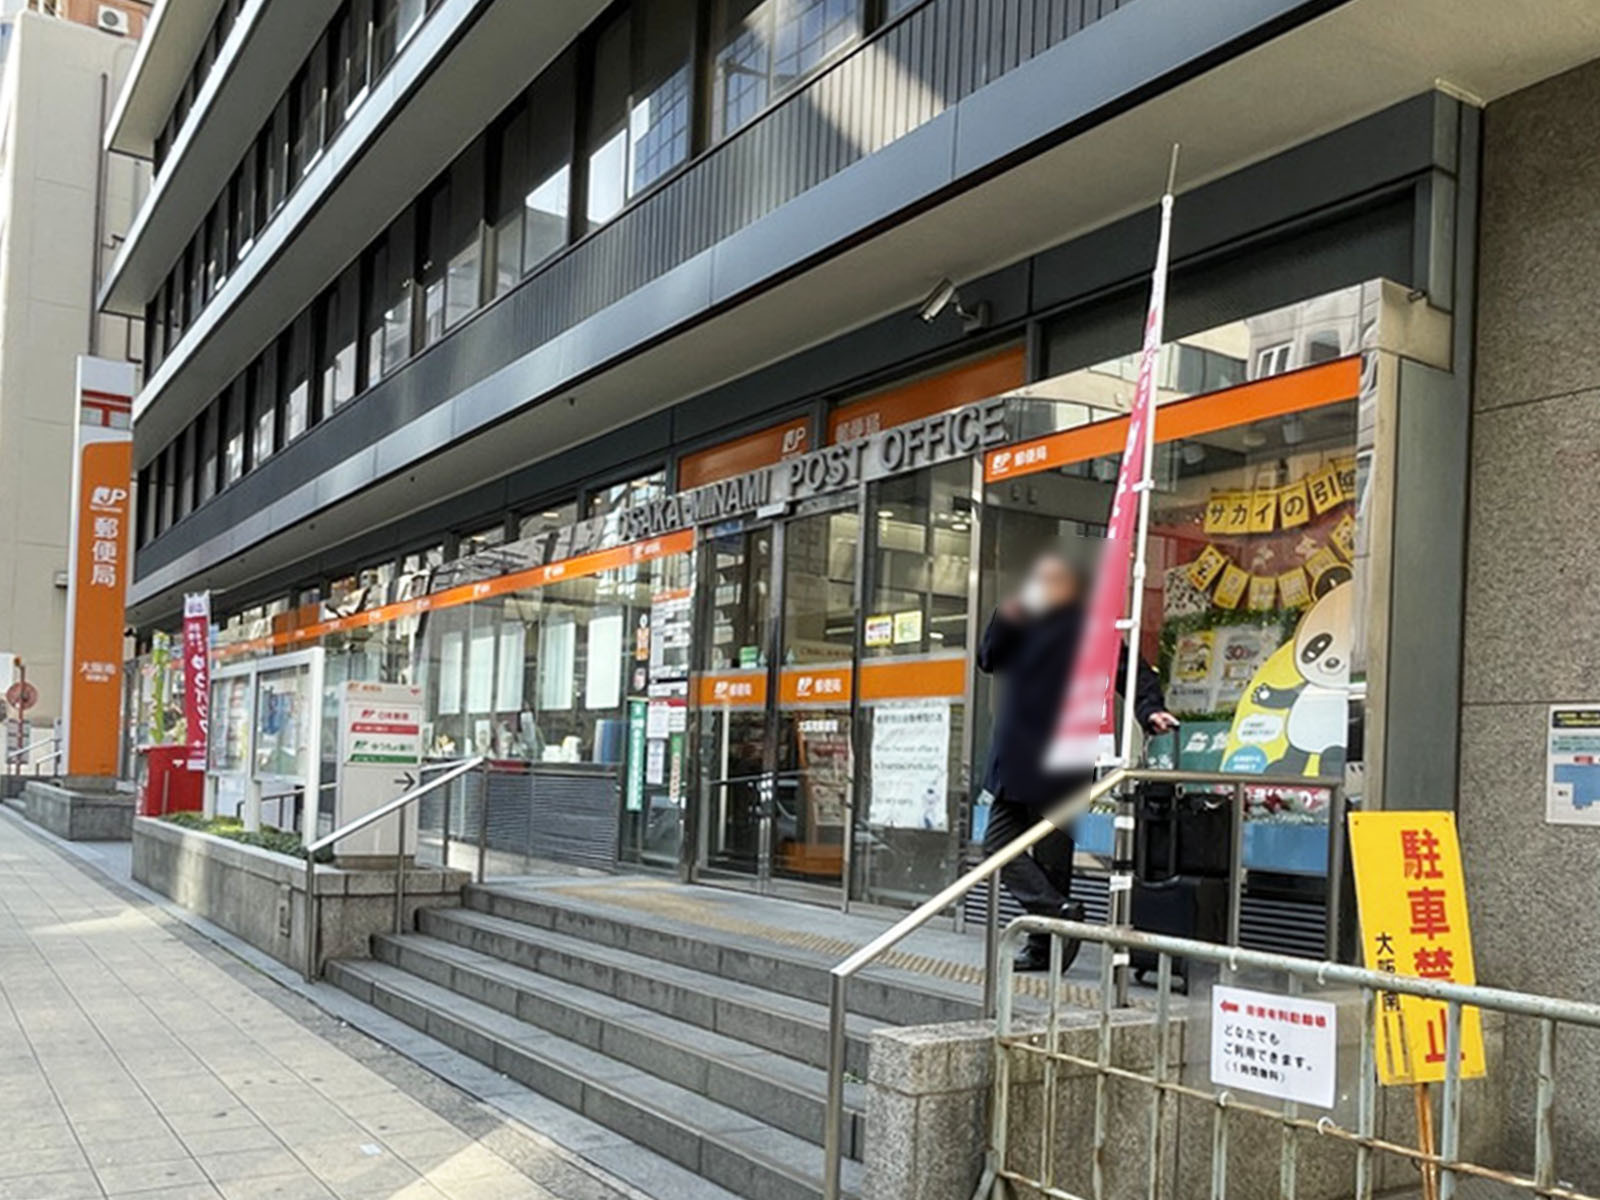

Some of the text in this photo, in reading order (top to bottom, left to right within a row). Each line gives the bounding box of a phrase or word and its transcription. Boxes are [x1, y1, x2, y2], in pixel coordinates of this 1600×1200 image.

[788, 438, 869, 498] POST
[878, 398, 1006, 472] OFFICE
[1014, 445, 1048, 467] 郵便局
[91, 516, 119, 588] 郵便局
[1400, 828, 1466, 1064] 駐車禁止
[1223, 1023, 1280, 1047] どなたでも
[1223, 1041, 1313, 1072] ご利用できます。
